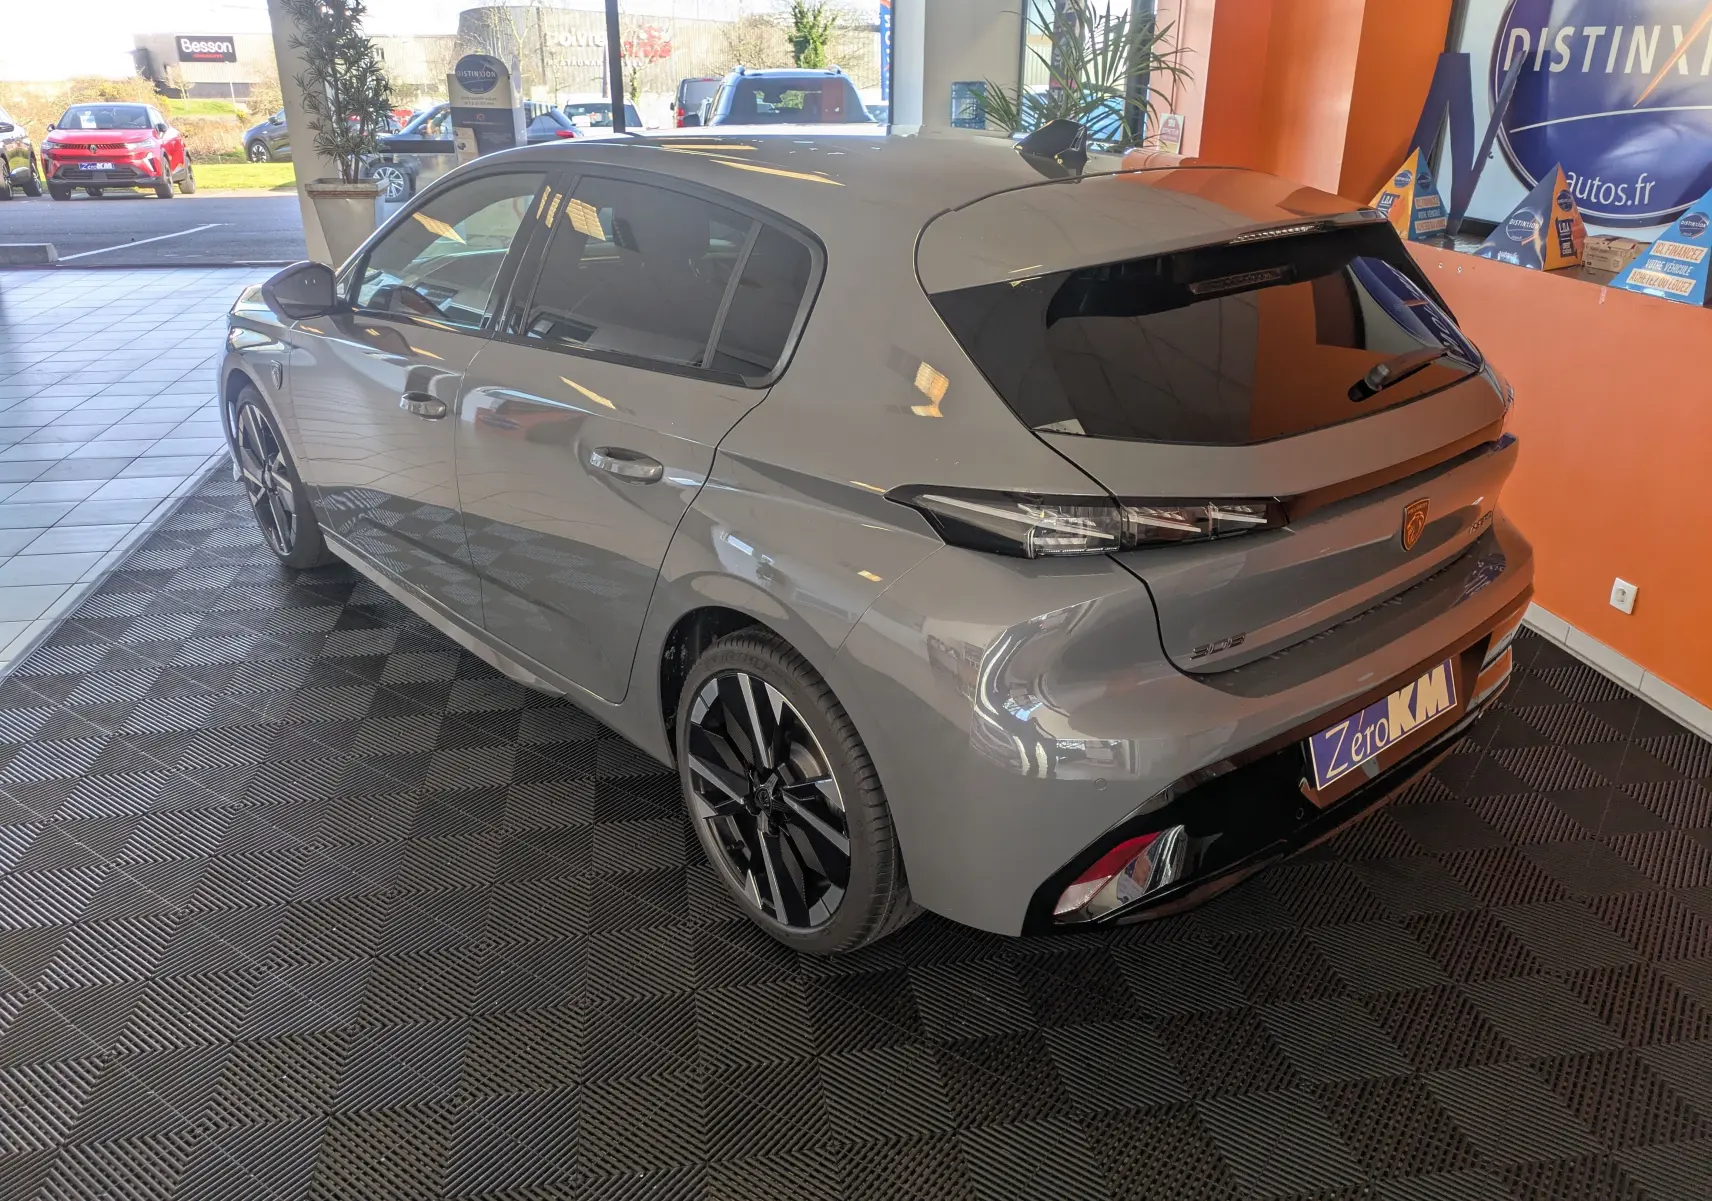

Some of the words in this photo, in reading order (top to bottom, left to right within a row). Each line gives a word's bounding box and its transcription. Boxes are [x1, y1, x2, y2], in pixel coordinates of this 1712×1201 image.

[181, 38, 233, 53] Besson
[457, 70, 496, 78] DISTINXION
[1566, 171, 1655, 206] autos.fr
[1509, 219, 1541, 229] DISTINXION
[1667, 244, 1705, 261] FINANCEZ
[1645, 258, 1665, 270] VOTRE
[1664, 260, 1694, 276] VÉHICULE
[1629, 271, 1658, 287] ACHETEZ
[1657, 276, 1668, 289] OU
[1668, 278, 1693, 293] LOUEZ
[1190, 632, 1246, 660] 308
